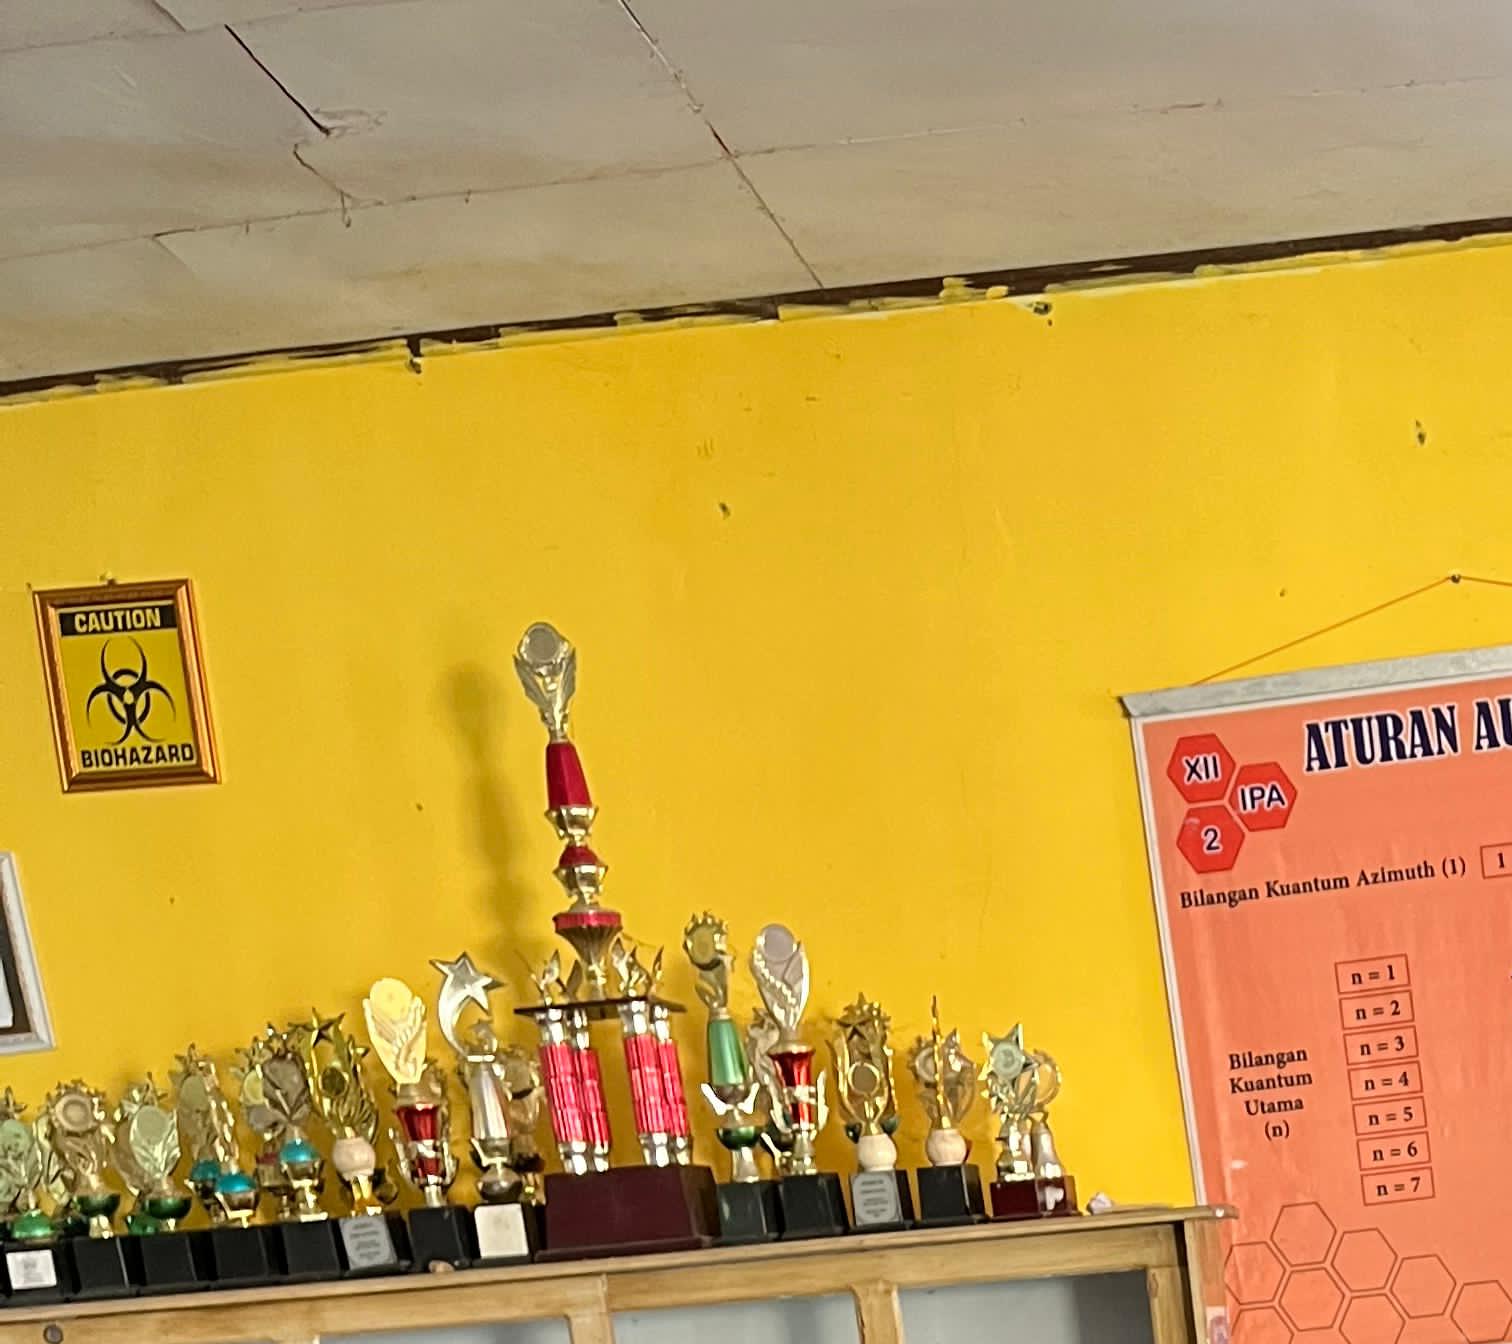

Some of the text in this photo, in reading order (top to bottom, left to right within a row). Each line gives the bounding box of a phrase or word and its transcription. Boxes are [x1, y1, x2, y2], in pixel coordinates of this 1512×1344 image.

[74, 608, 161, 633] CAUTION
[1304, 705, 1460, 772] ATURAN
[81, 743, 194, 768] BIOHAZARD
[1184, 754, 1220, 782] XII
[1240, 784, 1285, 811] IPA
[1204, 828, 1220, 850] 2
[1180, 884, 1260, 909] Bilangan
[1265, 875, 1350, 898] Kuantum
[1356, 860, 1436, 887] Azimuth
[1351, 972, 1362, 985] n
[1387, 964, 1395, 980] 1
[1356, 1008, 1367, 1020] n
[1390, 999, 1401, 1016] 2
[1360, 1043, 1371, 1056] n
[1394, 1035, 1405, 1051] 3
[1228, 1048, 1308, 1071] Bilangan
[1229, 1072, 1313, 1094] Kuantum
[1364, 1079, 1375, 1091] n
[1398, 1071, 1409, 1086] 4
[1244, 1098, 1304, 1116] Utama
[1368, 1114, 1379, 1126] n
[1403, 1106, 1413, 1122] 5
[1264, 1119, 1290, 1142] (n)
[1373, 1149, 1384, 1161] n
[1407, 1141, 1418, 1157] 6
[1377, 1184, 1388, 1196] n
[1410, 1176, 1421, 1192] 7
